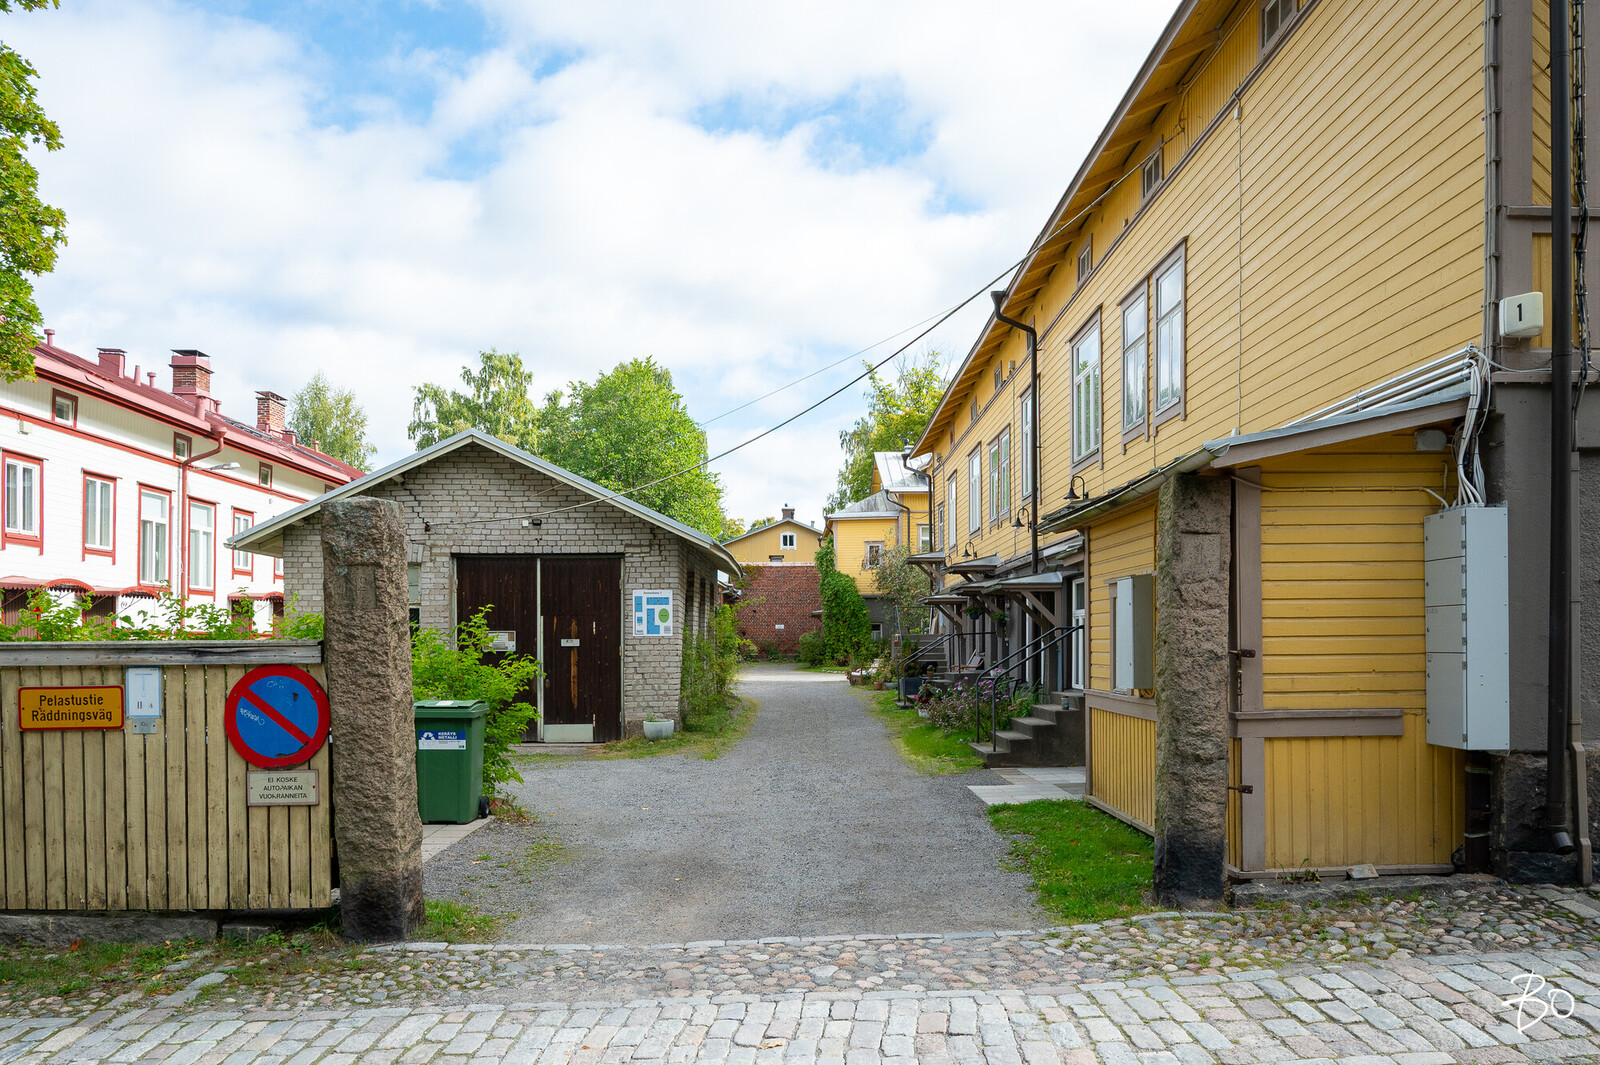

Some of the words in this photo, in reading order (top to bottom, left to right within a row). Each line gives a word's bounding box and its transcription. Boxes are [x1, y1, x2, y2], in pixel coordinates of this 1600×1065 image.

[1516, 302, 1523, 322] 1
[40, 694, 104, 706] Pelastustie
[32, 708, 112, 722] Räddningsväg
